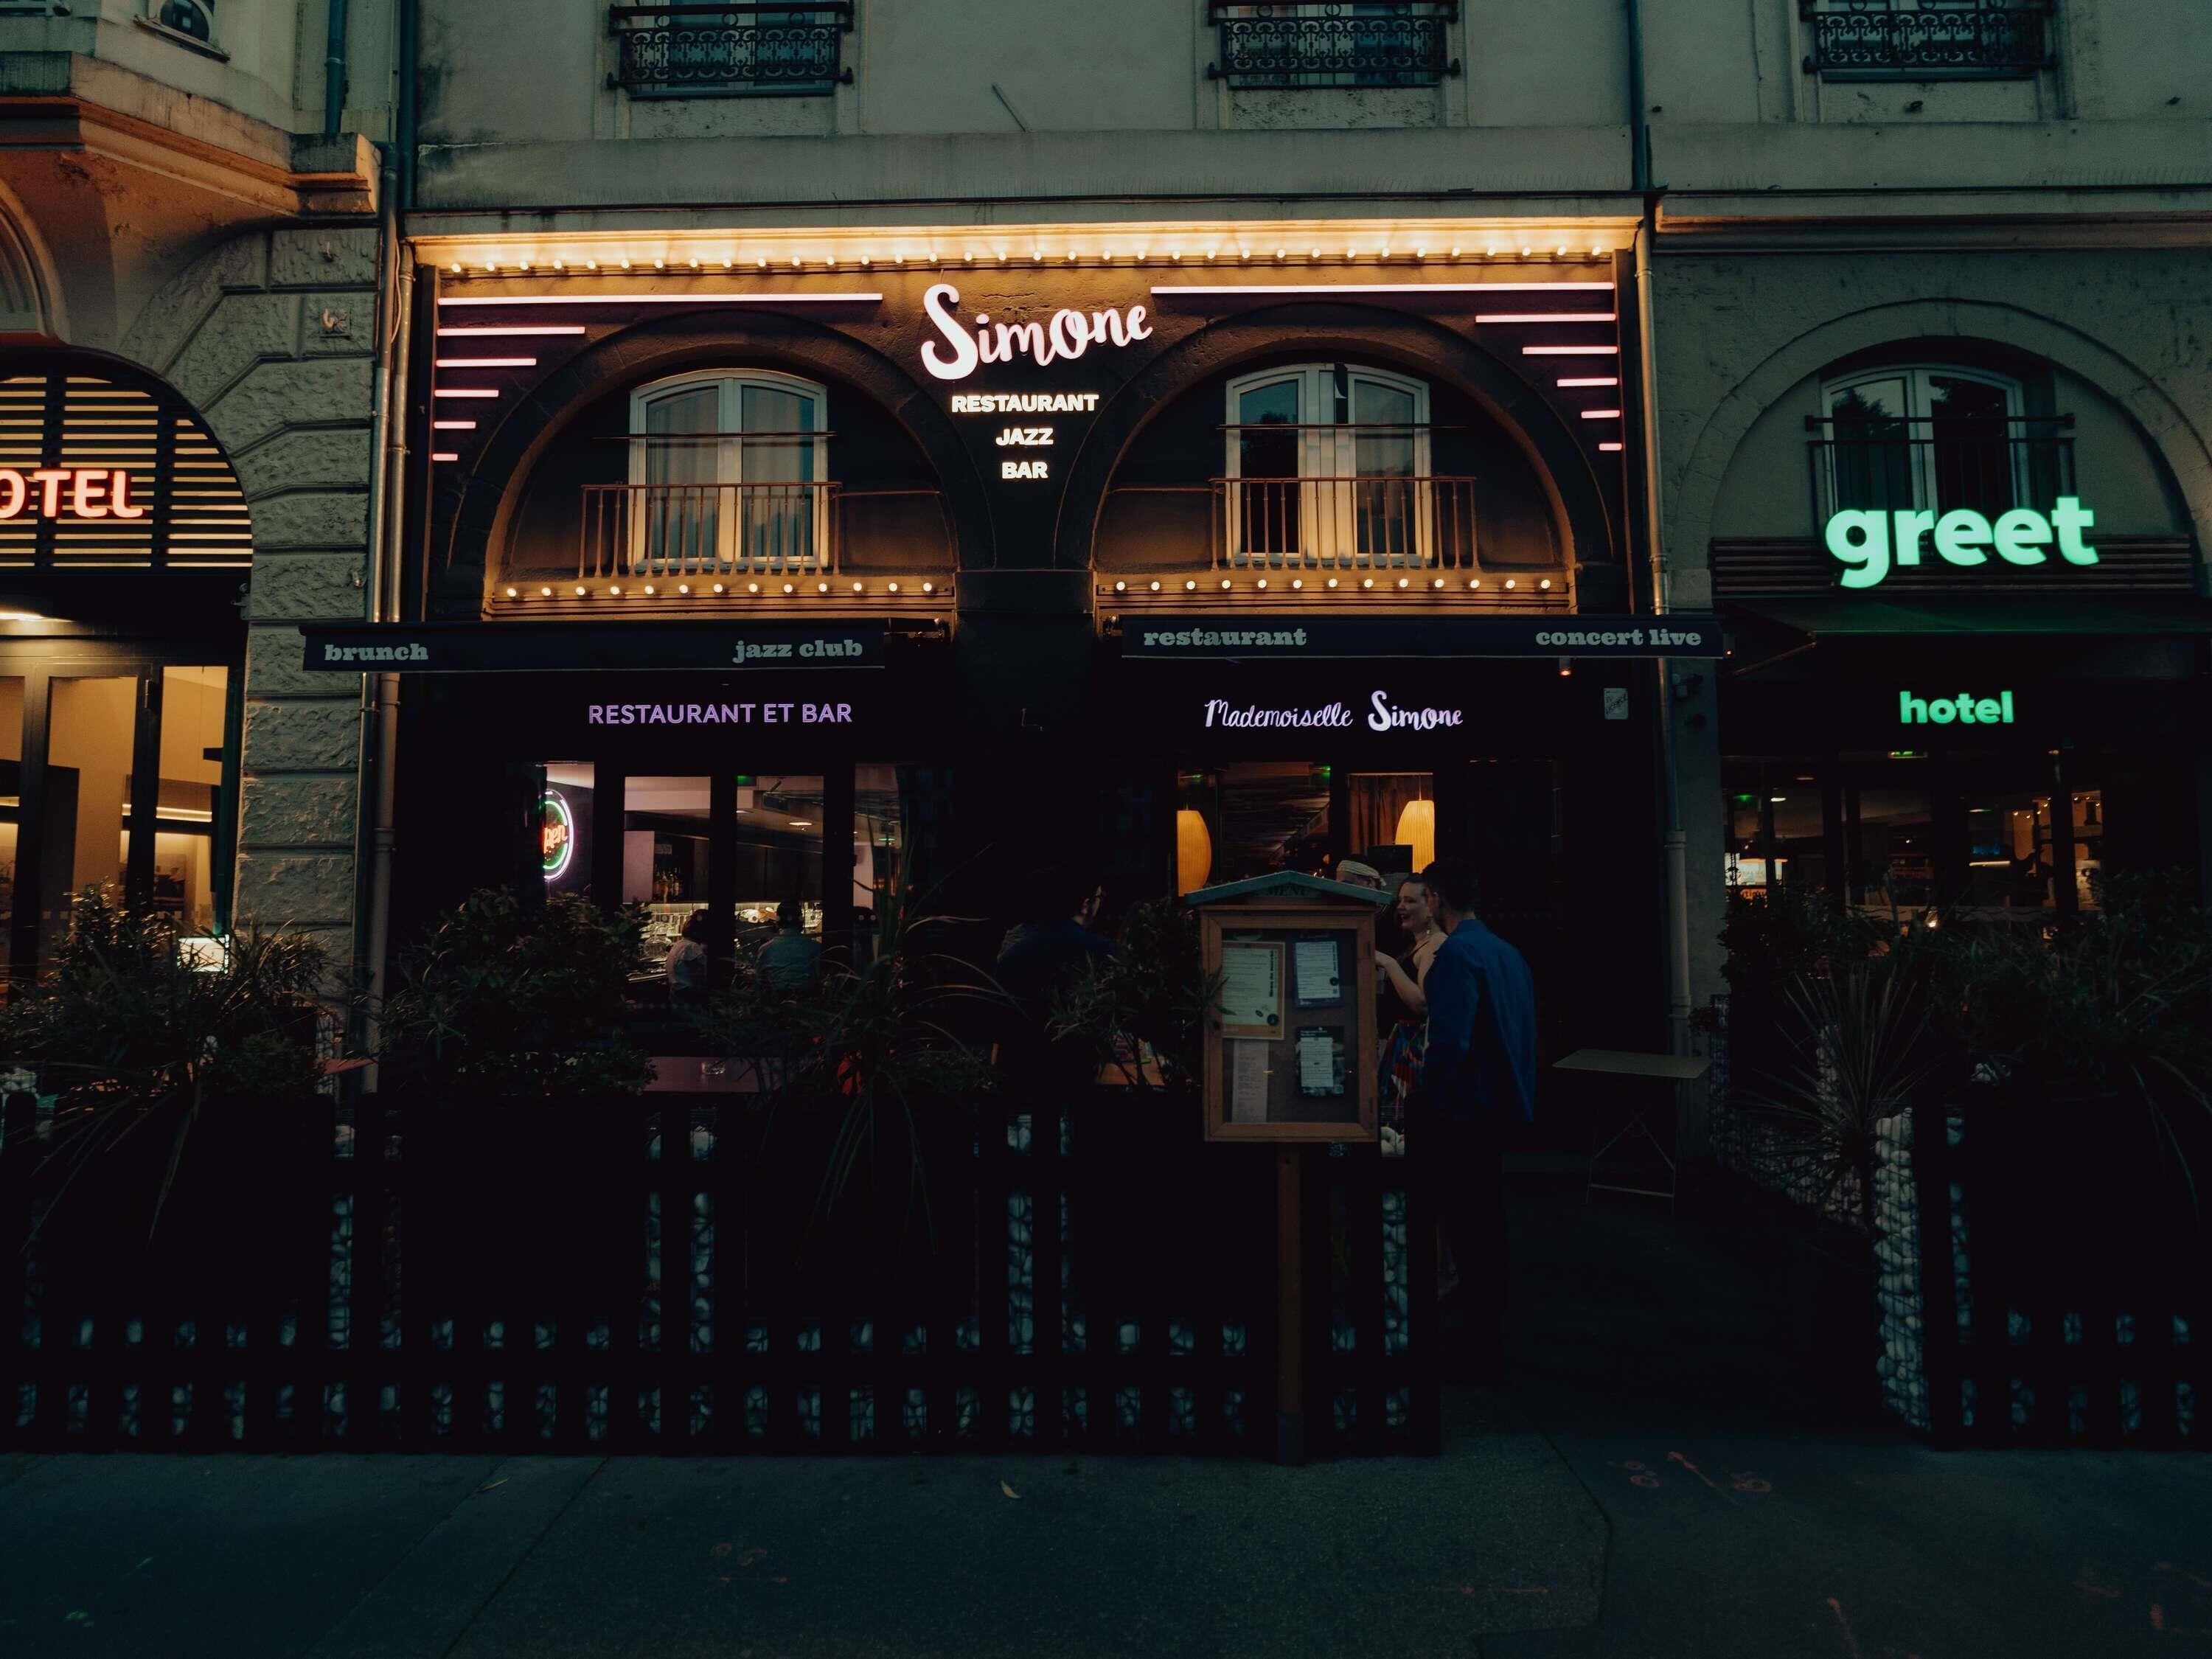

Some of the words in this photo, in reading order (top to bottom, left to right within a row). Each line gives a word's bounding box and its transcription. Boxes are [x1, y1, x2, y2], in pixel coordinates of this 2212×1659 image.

[922, 284, 1152, 380] Simone
[951, 394, 1099, 413] RESTAURANT
[995, 428, 1054, 445] JAZZ
[1001, 462, 1048, 479] BAR
[1825, 496, 2100, 588] greet
[1144, 628, 1307, 646] restaurant
[1535, 629, 1644, 646] concert
[1649, 628, 1702, 646] live
[324, 643, 429, 661] brunch
[732, 640, 793, 663] jazz
[799, 639, 863, 657] club
[588, 703, 757, 724] RESTAURANT
[763, 703, 795, 723] ET
[801, 703, 852, 723] BAR
[1205, 698, 1354, 727] Mademoiselle
[1368, 689, 1464, 731] Simone
[1899, 691, 2014, 723] hotel
[543, 824, 568, 854] pen
